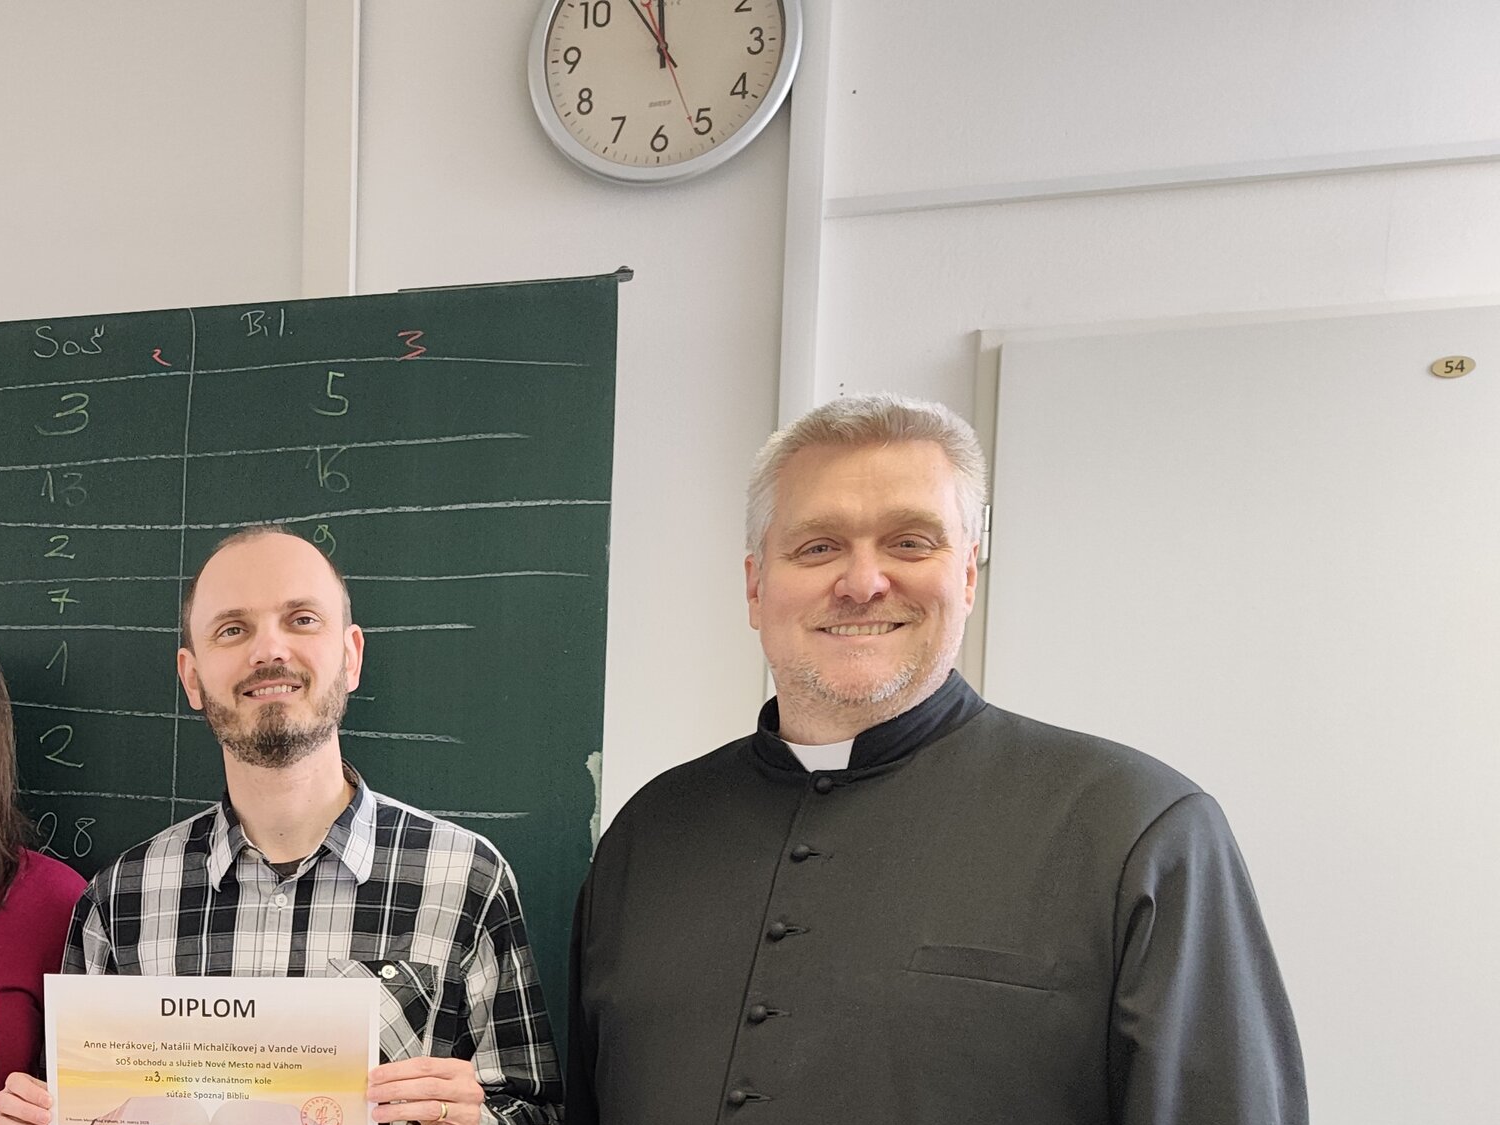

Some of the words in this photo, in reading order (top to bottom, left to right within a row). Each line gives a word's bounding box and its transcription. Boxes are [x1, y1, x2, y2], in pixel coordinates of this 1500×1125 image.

[580, 1, 611, 29] 10
[747, 26, 765, 55] 3
[563, 46, 582, 75] 9
[730, 72, 749, 99] 4
[577, 87, 593, 115] 8
[611, 115, 627, 144] 7
[693, 107, 713, 135] 5
[650, 125, 669, 152] 6
[397, 329, 428, 361] 3
[1443, 359, 1466, 374] 54
[307, 369, 350, 417] 5
[33, 391, 91, 437] 3
[304, 447, 351, 494] 16
[40, 470, 88, 508] 13
[43, 533, 77, 561] 2
[47, 587, 81, 615] 7
[45, 639, 69, 687] 1
[38, 723, 85, 769] 2
[35, 810, 97, 861] 28
[160, 998, 256, 1018] DIPLOM
[83, 1040, 107, 1049] Anne
[109, 1040, 158, 1052] Herákovej,
[160, 1042, 191, 1051] Natálii
[193, 1042, 258, 1055] Michalčíkovej
[267, 1044, 298, 1054] Vande
[300, 1044, 337, 1056] Vidovej
[115, 1056, 131, 1066] SOŠ
[133, 1058, 167, 1067] obchodu
[175, 1059, 203, 1068] služieb
[205, 1060, 226, 1069] Nové
[228, 1061, 254, 1069] Mesto
[255, 1061, 271, 1069] nad
[273, 1061, 302, 1070] Váhom
[166, 1075, 193, 1084] miesto
[201, 1075, 253, 1085] dekanátnom
[254, 1076, 272, 1085] kole
[166, 1090, 192, 1099] súťaže
[193, 1091, 225, 1101] Spoznaj
[226, 1092, 250, 1100] Bibliu
